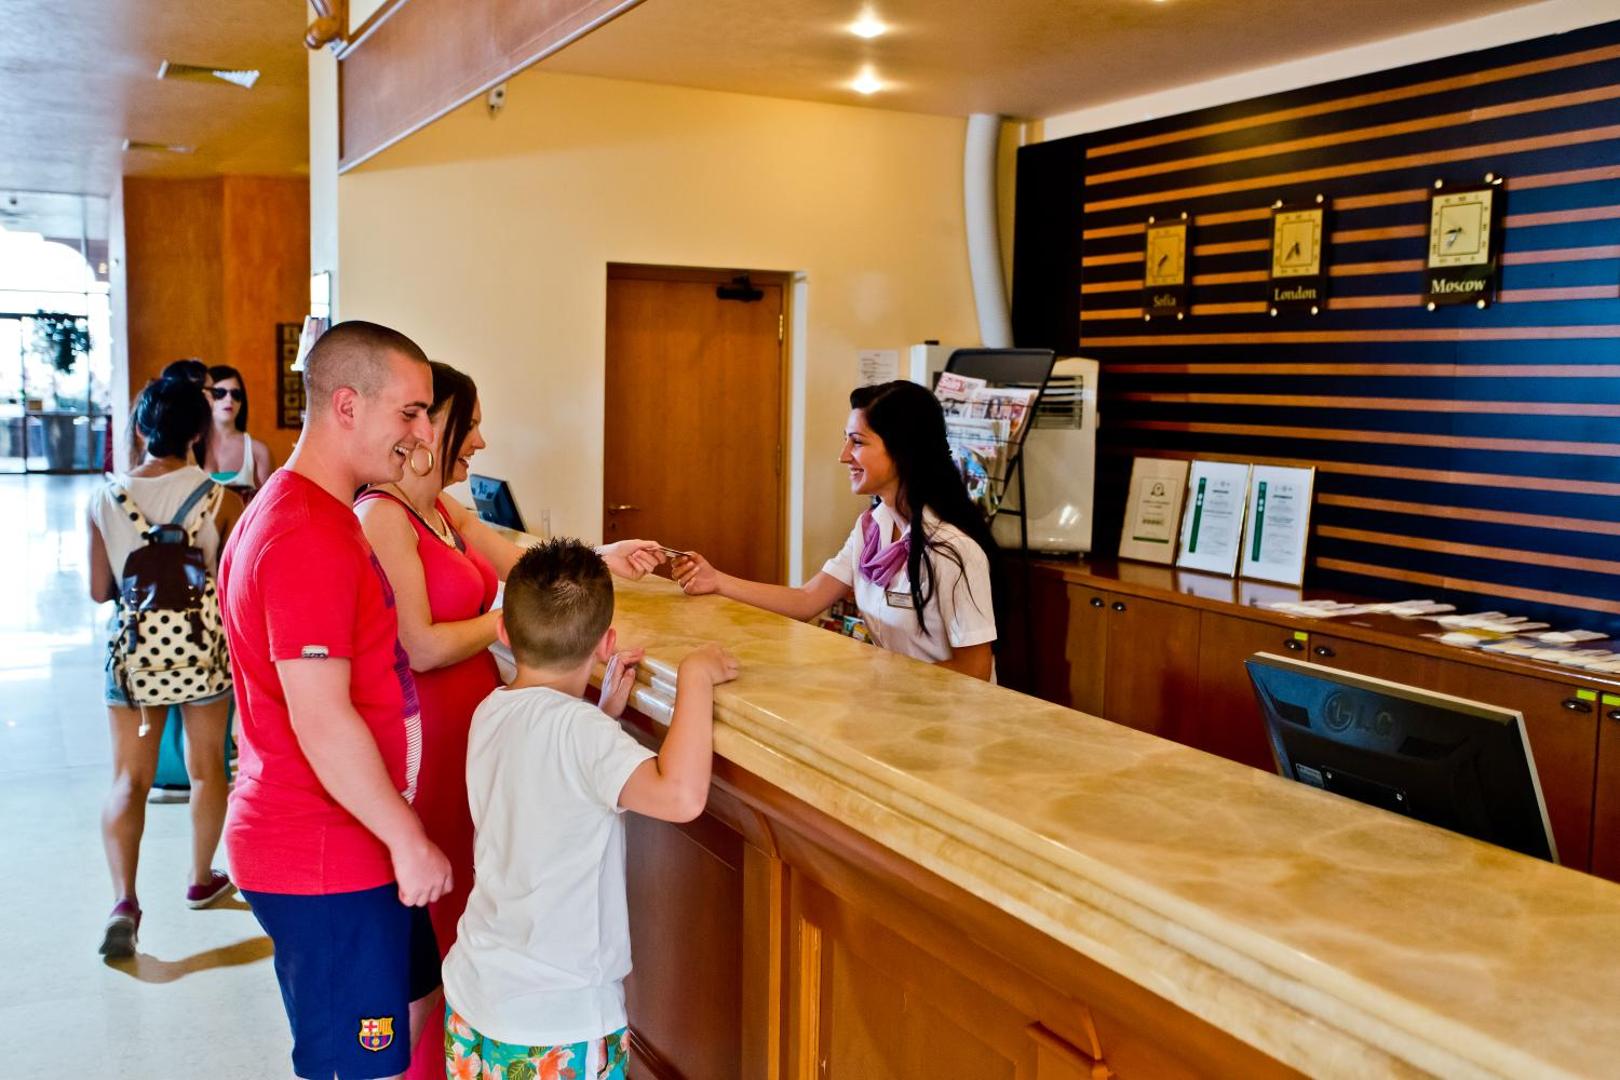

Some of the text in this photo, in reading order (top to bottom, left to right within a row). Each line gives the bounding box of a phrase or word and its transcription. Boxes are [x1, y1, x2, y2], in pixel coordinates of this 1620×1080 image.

[1274, 285, 1317, 301] London
[1431, 278, 1486, 294] Moscow
[1153, 295, 1177, 308] Sofia
